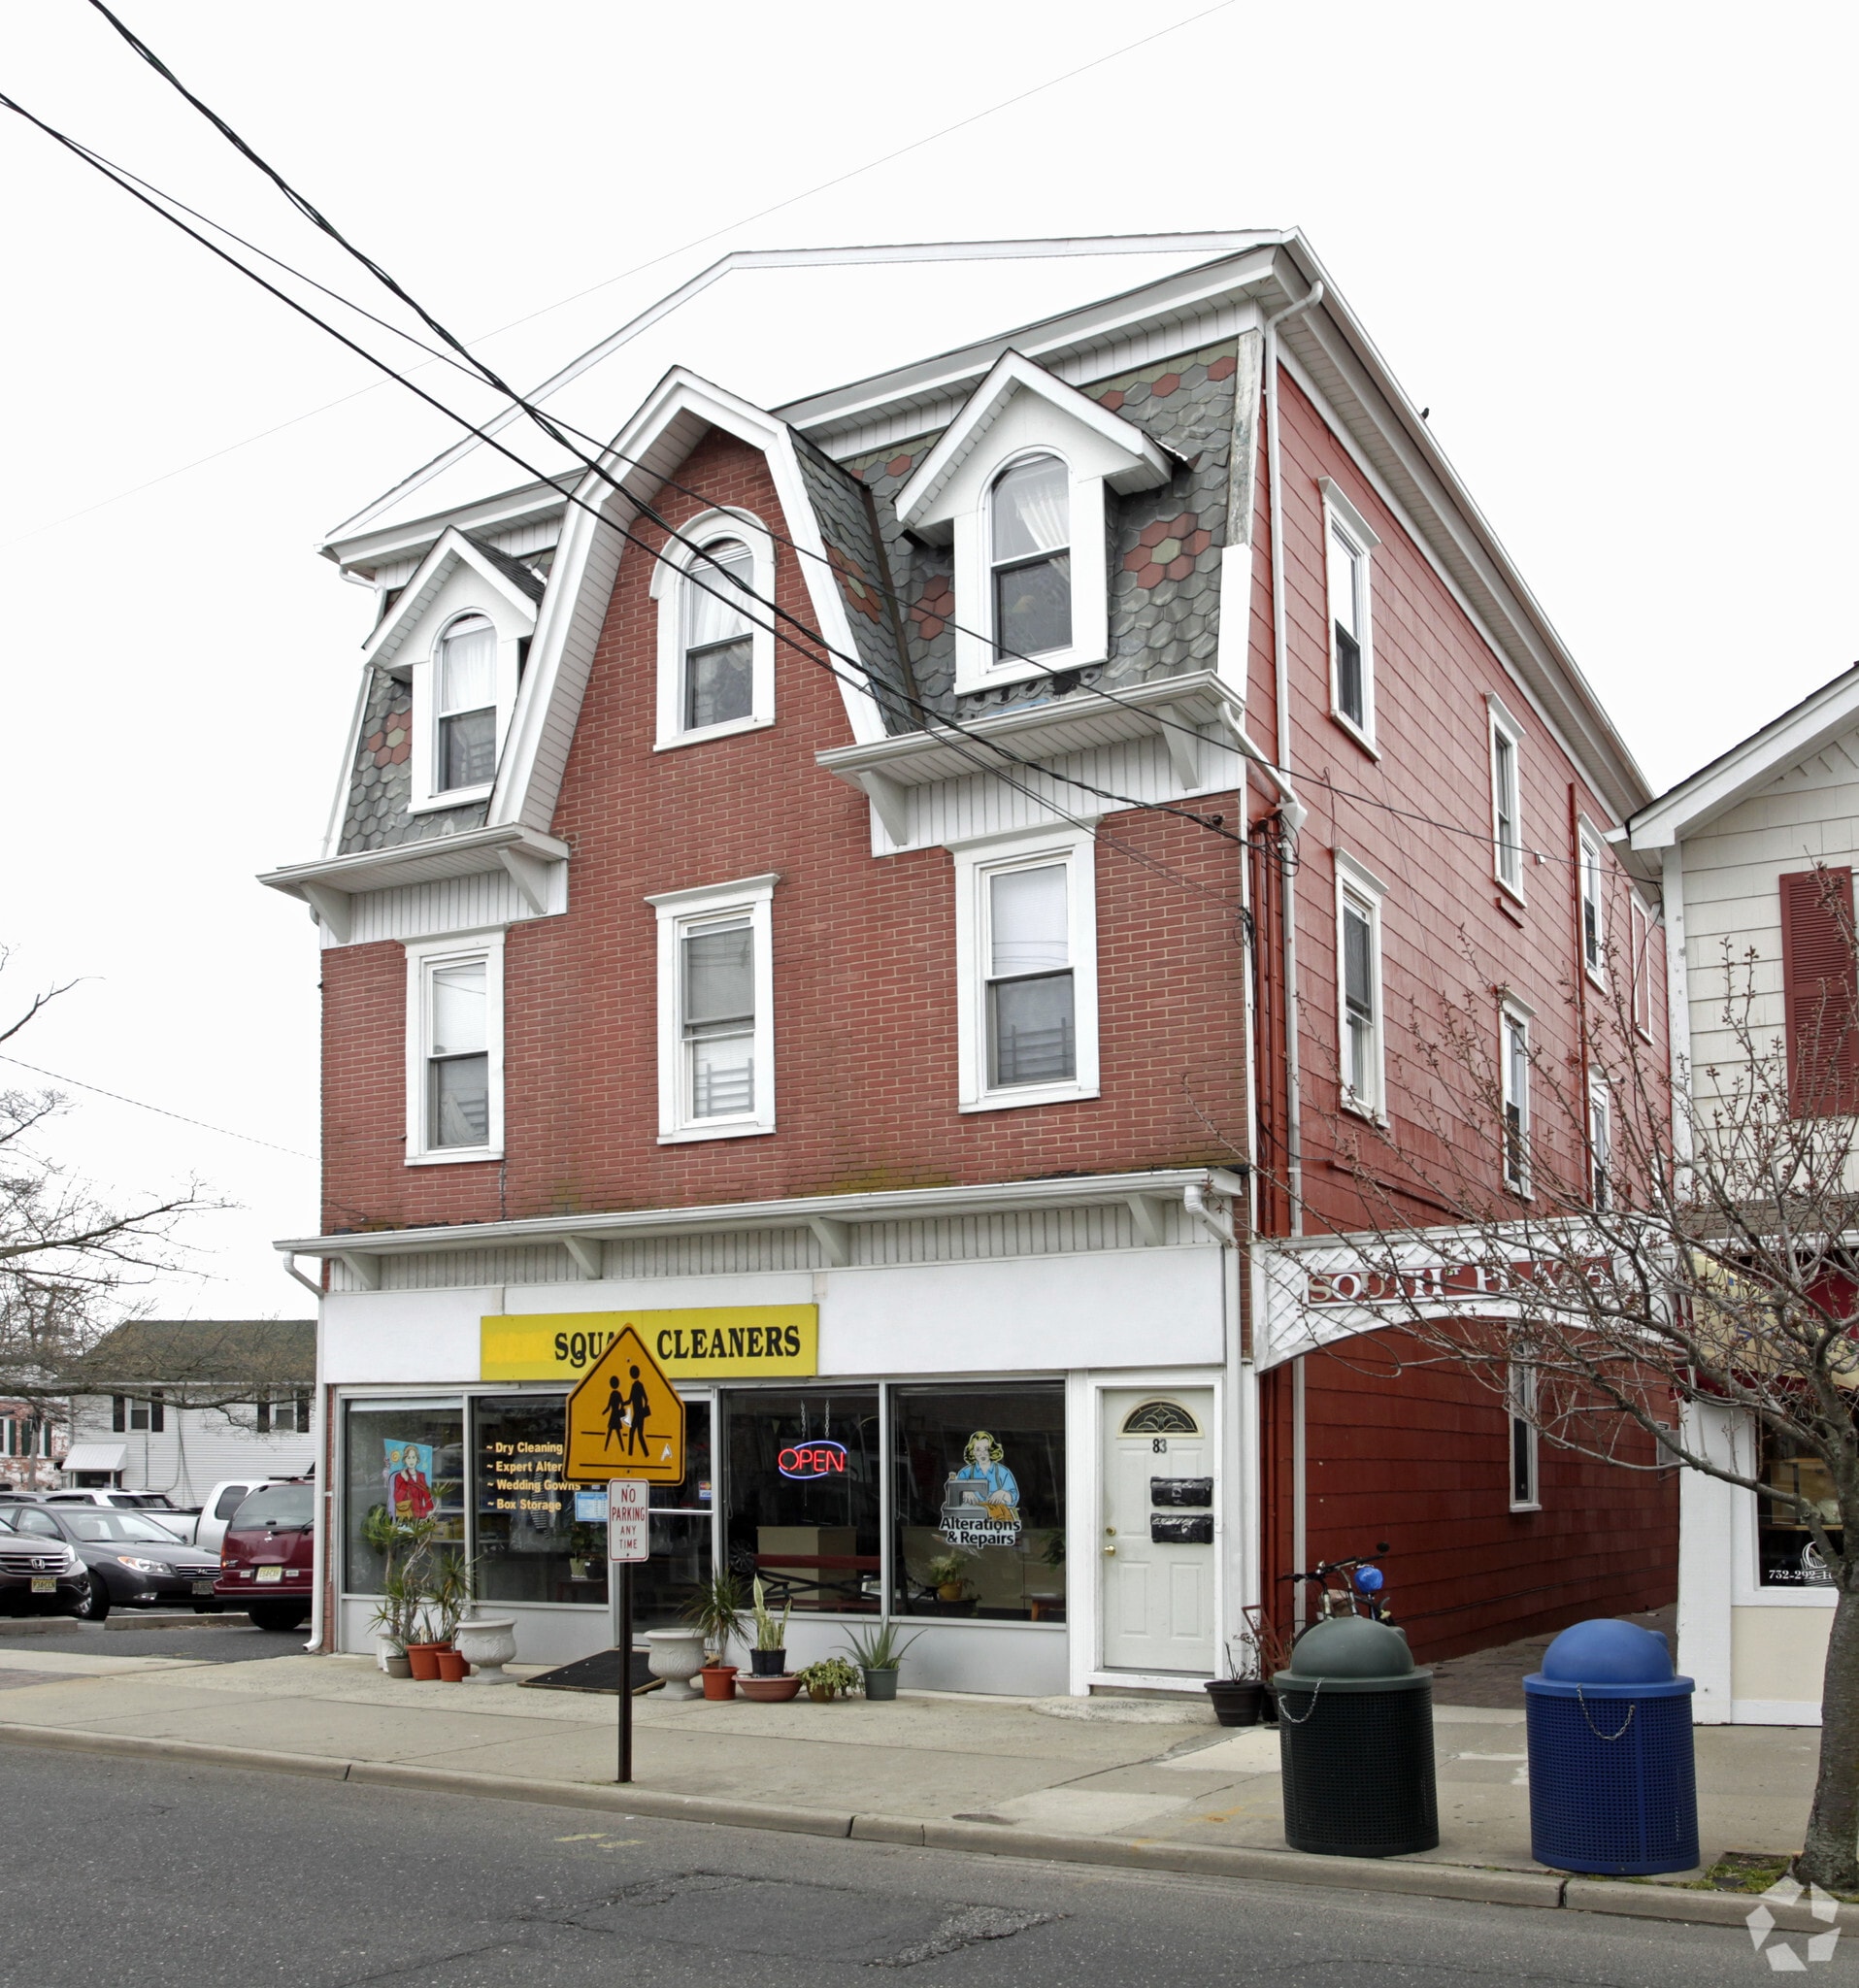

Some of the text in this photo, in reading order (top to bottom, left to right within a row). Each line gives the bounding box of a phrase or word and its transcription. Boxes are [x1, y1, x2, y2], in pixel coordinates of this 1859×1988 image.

[657, 1325, 801, 1360] CLEANERS
[495, 1441, 563, 1456] Dry Cleaning
[1152, 1438, 1168, 1454] 83
[495, 1460, 533, 1475] Expert
[778, 1447, 845, 1473] OPEN
[496, 1478, 581, 1493] Wedding Gowns
[620, 1488, 636, 1504] NO
[496, 1498, 516, 1509] Box
[519, 1498, 562, 1513] Storage
[612, 1507, 646, 1522] PARKING
[620, 1525, 637, 1536] ANY
[940, 1516, 1021, 1531] Alterations
[619, 1539, 638, 1550] TIME
[946, 1530, 1014, 1548] & Repairs
